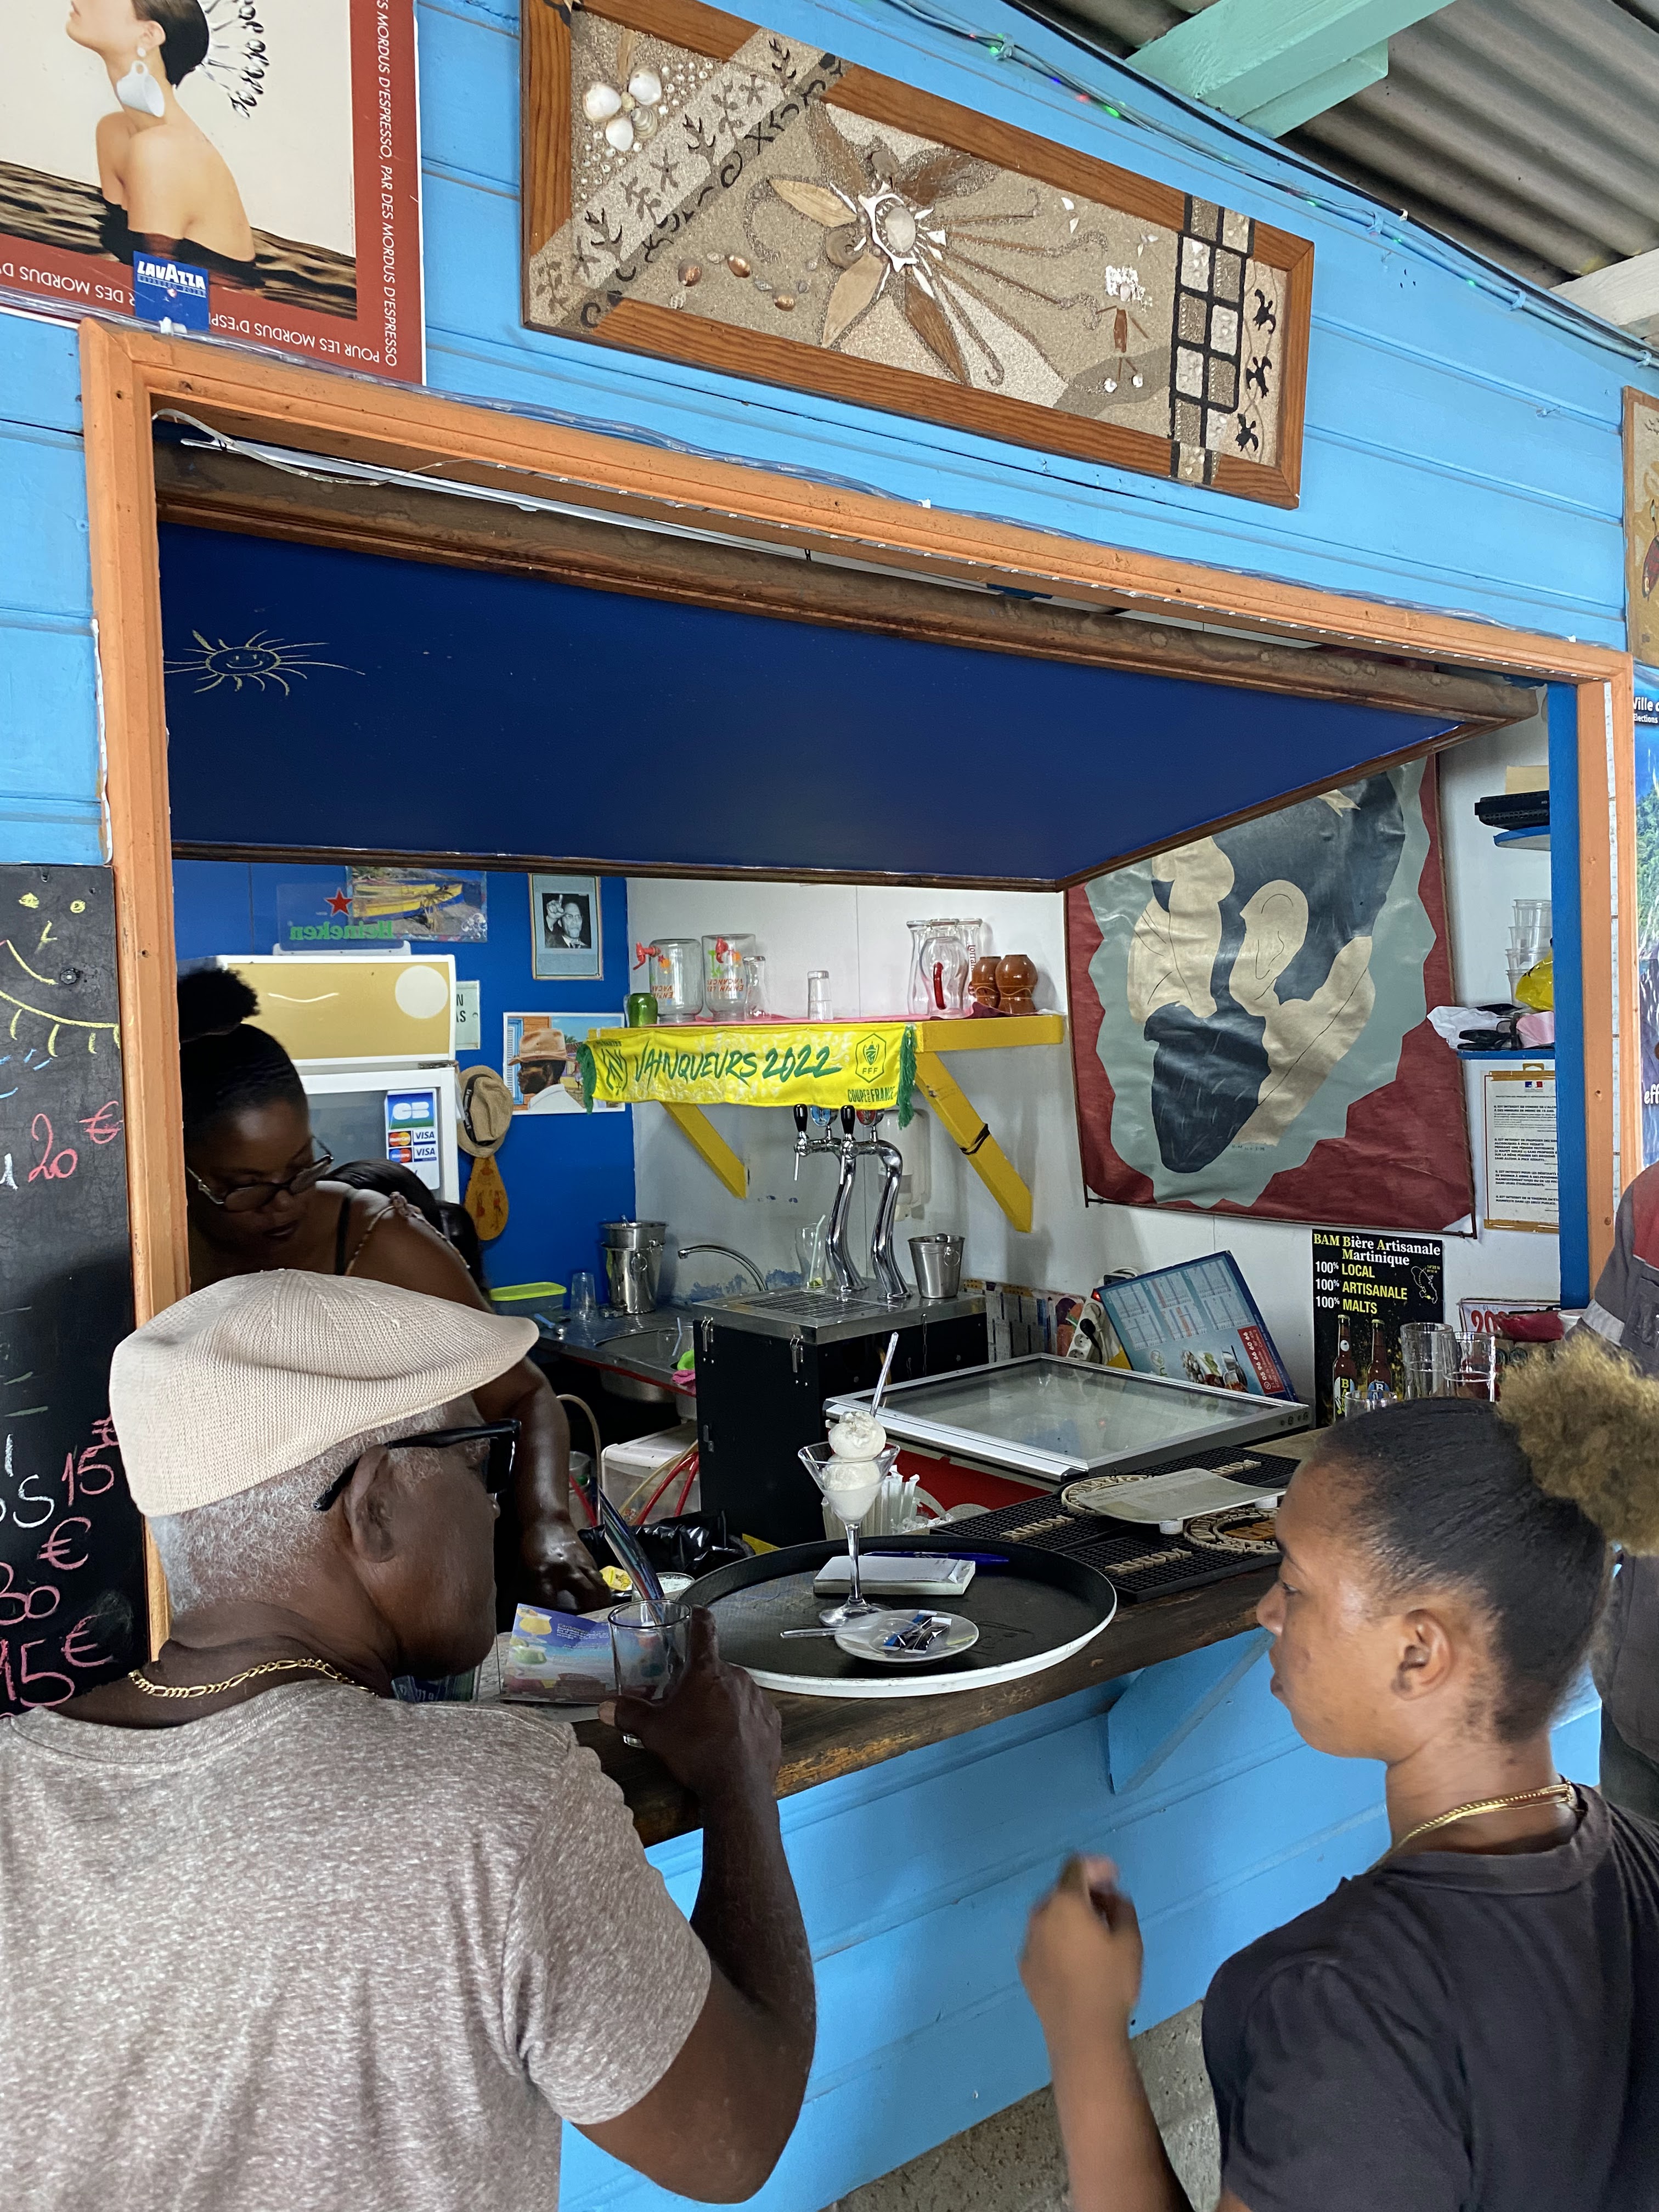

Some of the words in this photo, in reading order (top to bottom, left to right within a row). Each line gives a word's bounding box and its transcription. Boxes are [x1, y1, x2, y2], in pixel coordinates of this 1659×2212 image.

[376, 11, 391, 74] MORDUS
[378, 76, 393, 160] D'ESPRESSO,
[380, 165, 393, 190] PAR
[381, 193, 394, 220] DES
[382, 222, 396, 284] MORDUS
[19, 266, 91, 296] MORDUS
[137, 260, 206, 290] LAVAZZA
[95, 284, 124, 303] DES
[254, 323, 315, 348] MORDUS
[383, 286, 397, 366] D'ESPRESSO
[319, 338, 340, 354] LES
[345, 343, 380, 363] POUR
[634, 1040, 758, 1090] VAINQUEURS
[762, 1044, 843, 1082] 2022
[28, 1113, 78, 1183] 20
[417, 1148, 435, 1156] VISA
[1313, 1233, 1340, 1246] BAM
[1342, 1235, 1374, 1249] Bière
[1376, 1239, 1441, 1256] Artisanale
[1342, 1249, 1410, 1267] Martinique
[1316, 1261, 1339, 1273] 100%
[1342, 1263, 1375, 1278] LOCAL
[1316, 1278, 1340, 1291] 100%
[1342, 1281, 1408, 1300] ARTISANALE
[1316, 1295, 1340, 1308] 100%
[1343, 1299, 1378, 1314] MALTS
[61, 1448, 115, 1507] 15
[1000, 1514, 1075, 1542] RHUM
[37, 1516, 92, 1570] €
[1104, 1547, 1193, 1575] RHUM
[61, 1614, 112, 1668] €
